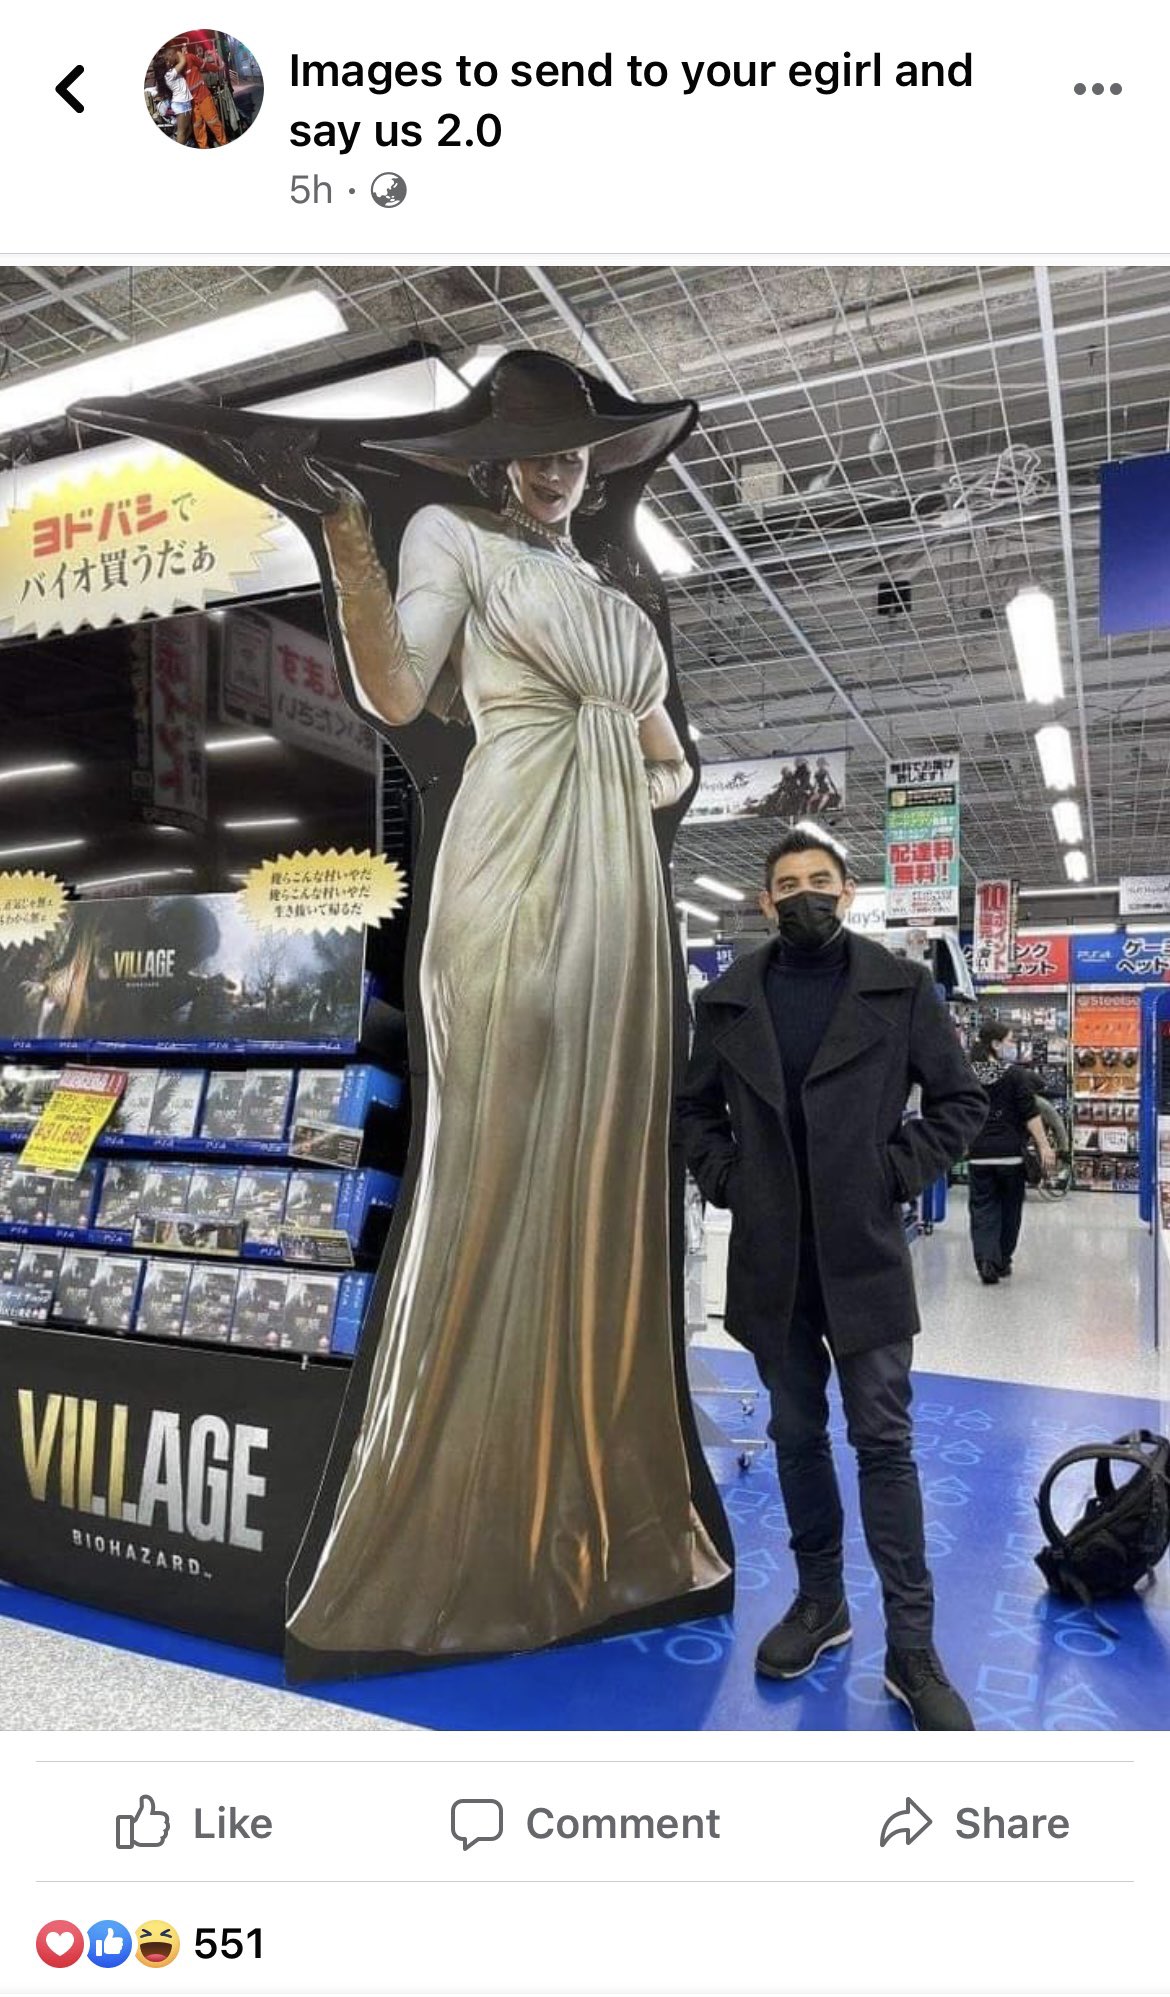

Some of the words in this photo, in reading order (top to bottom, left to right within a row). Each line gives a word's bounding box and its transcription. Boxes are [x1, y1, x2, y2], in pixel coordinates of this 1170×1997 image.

[33, 492, 197, 558] ヨドバシで
[114, 949, 176, 979] VILLAGE
[18, 1389, 269, 1552] VILLAGE
[72, 1529, 201, 1575] BIOHAZARD
